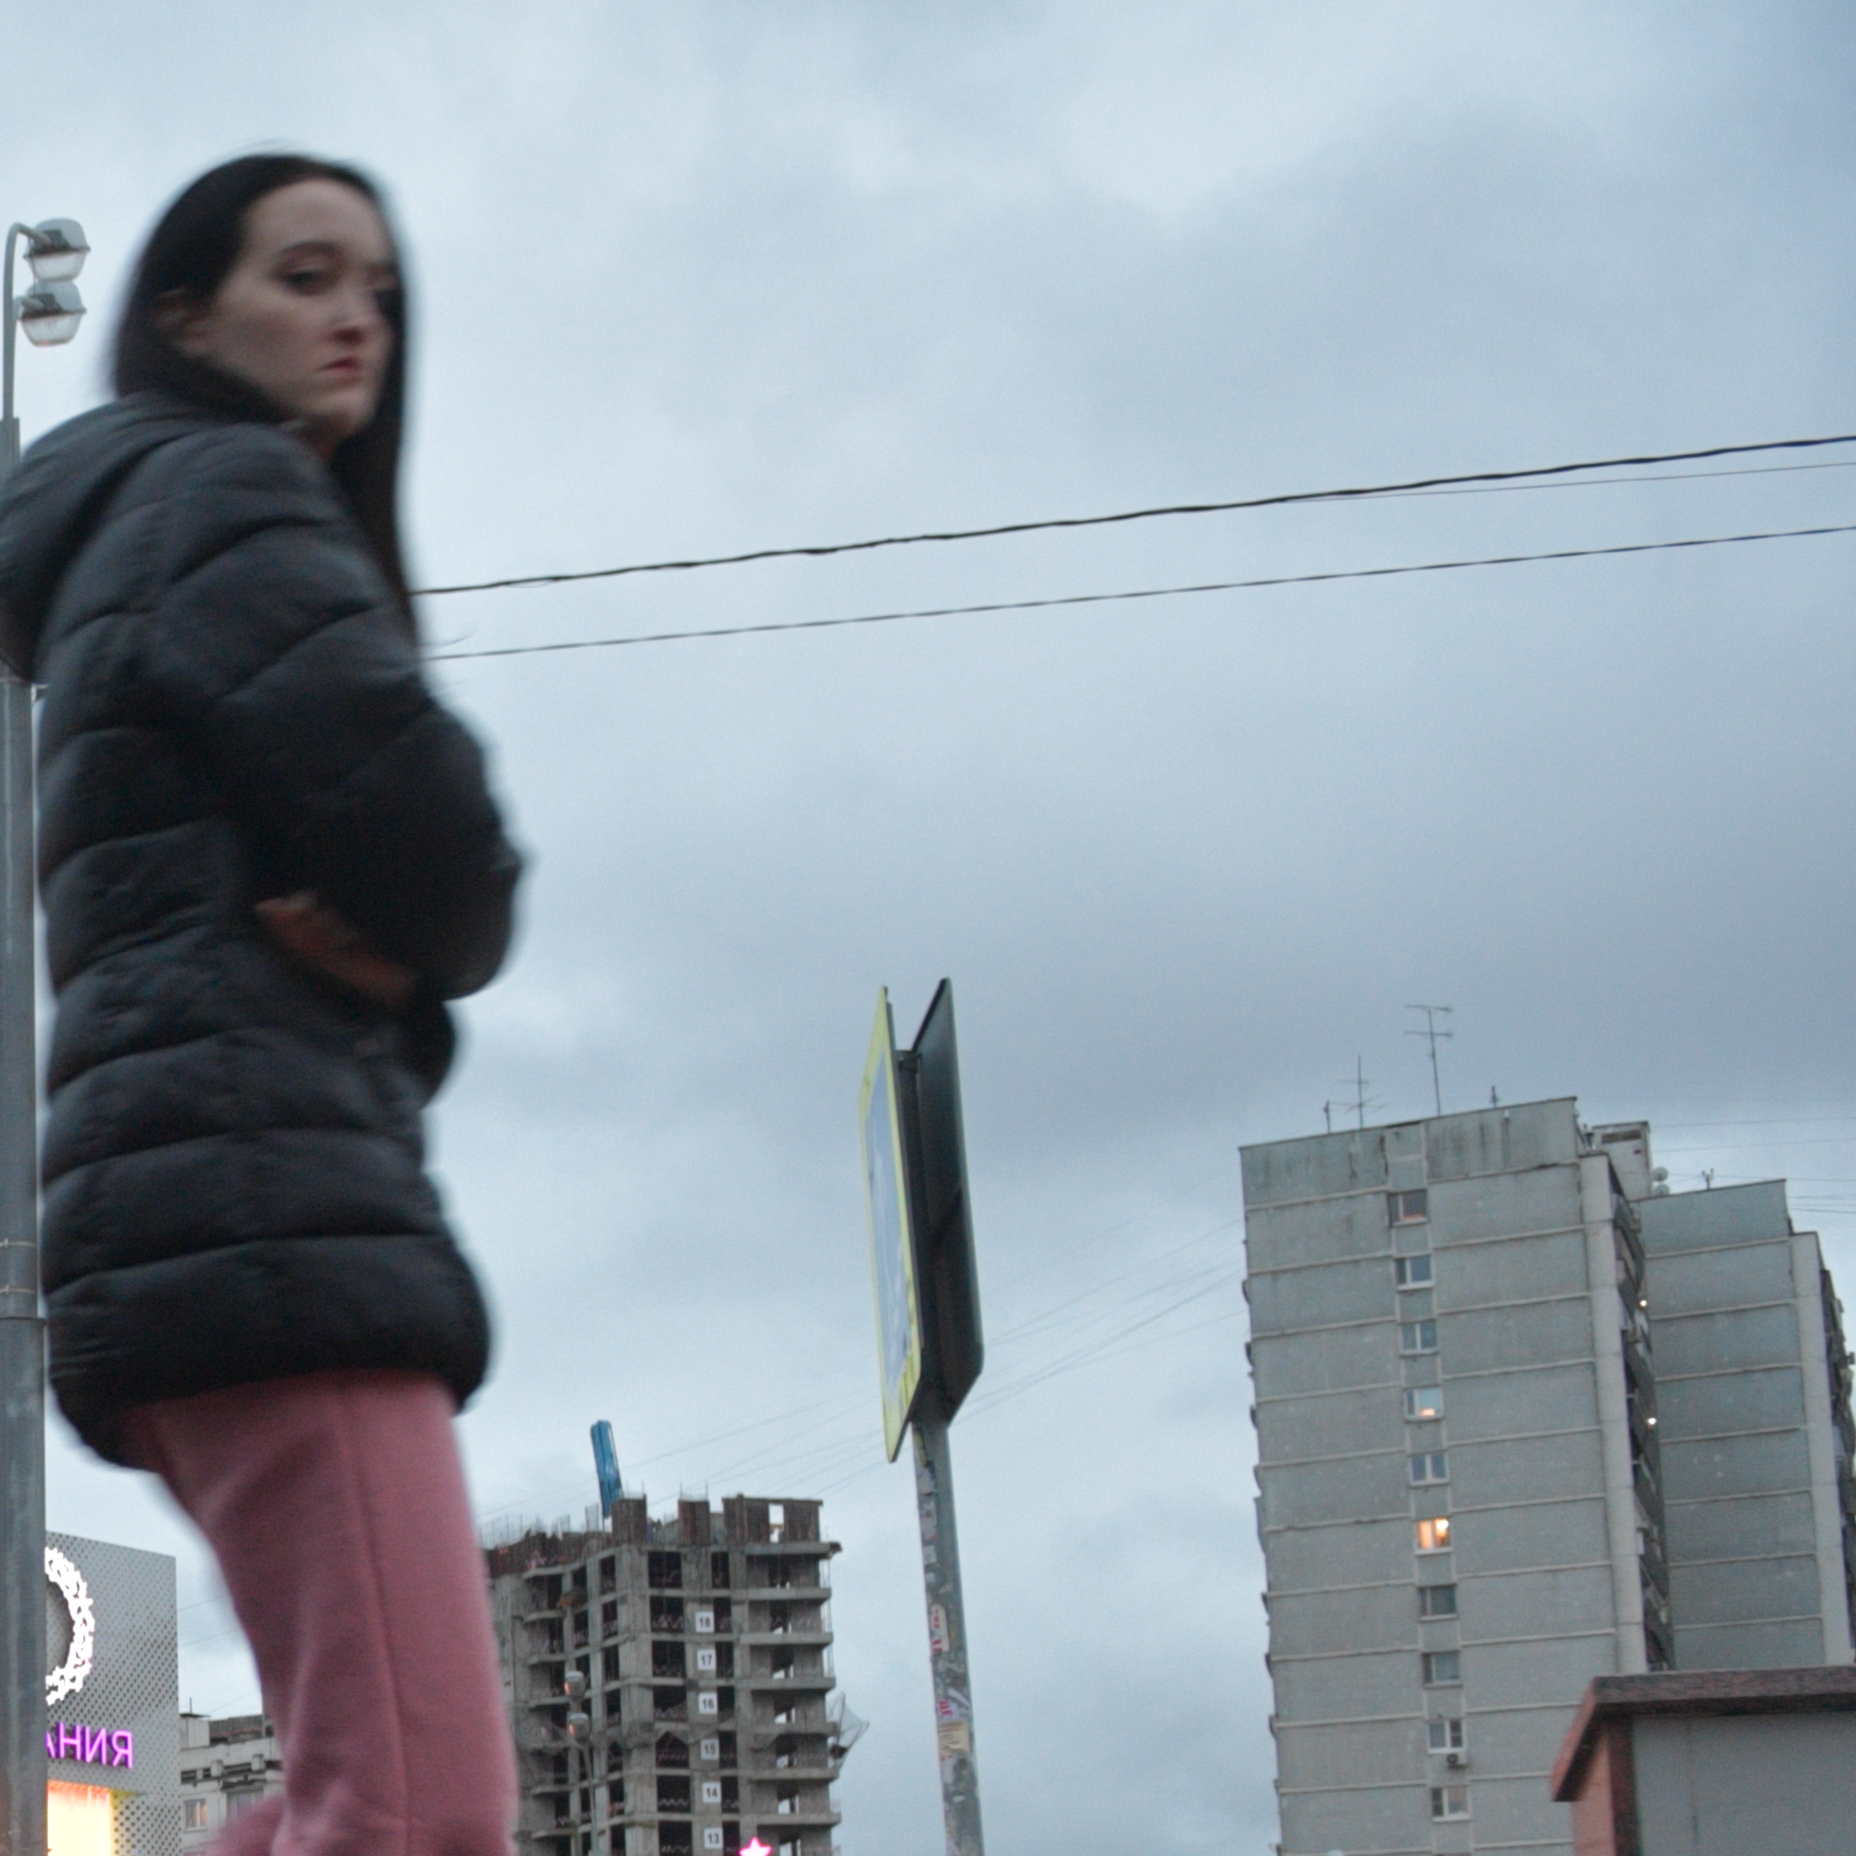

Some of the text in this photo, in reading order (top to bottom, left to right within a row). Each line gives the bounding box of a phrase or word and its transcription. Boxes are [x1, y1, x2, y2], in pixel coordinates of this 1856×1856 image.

[701, 1654, 713, 1667] 17
[703, 1698, 715, 1711] 16
[706, 1787, 718, 1800] 14
[708, 1832, 720, 1845] 13
